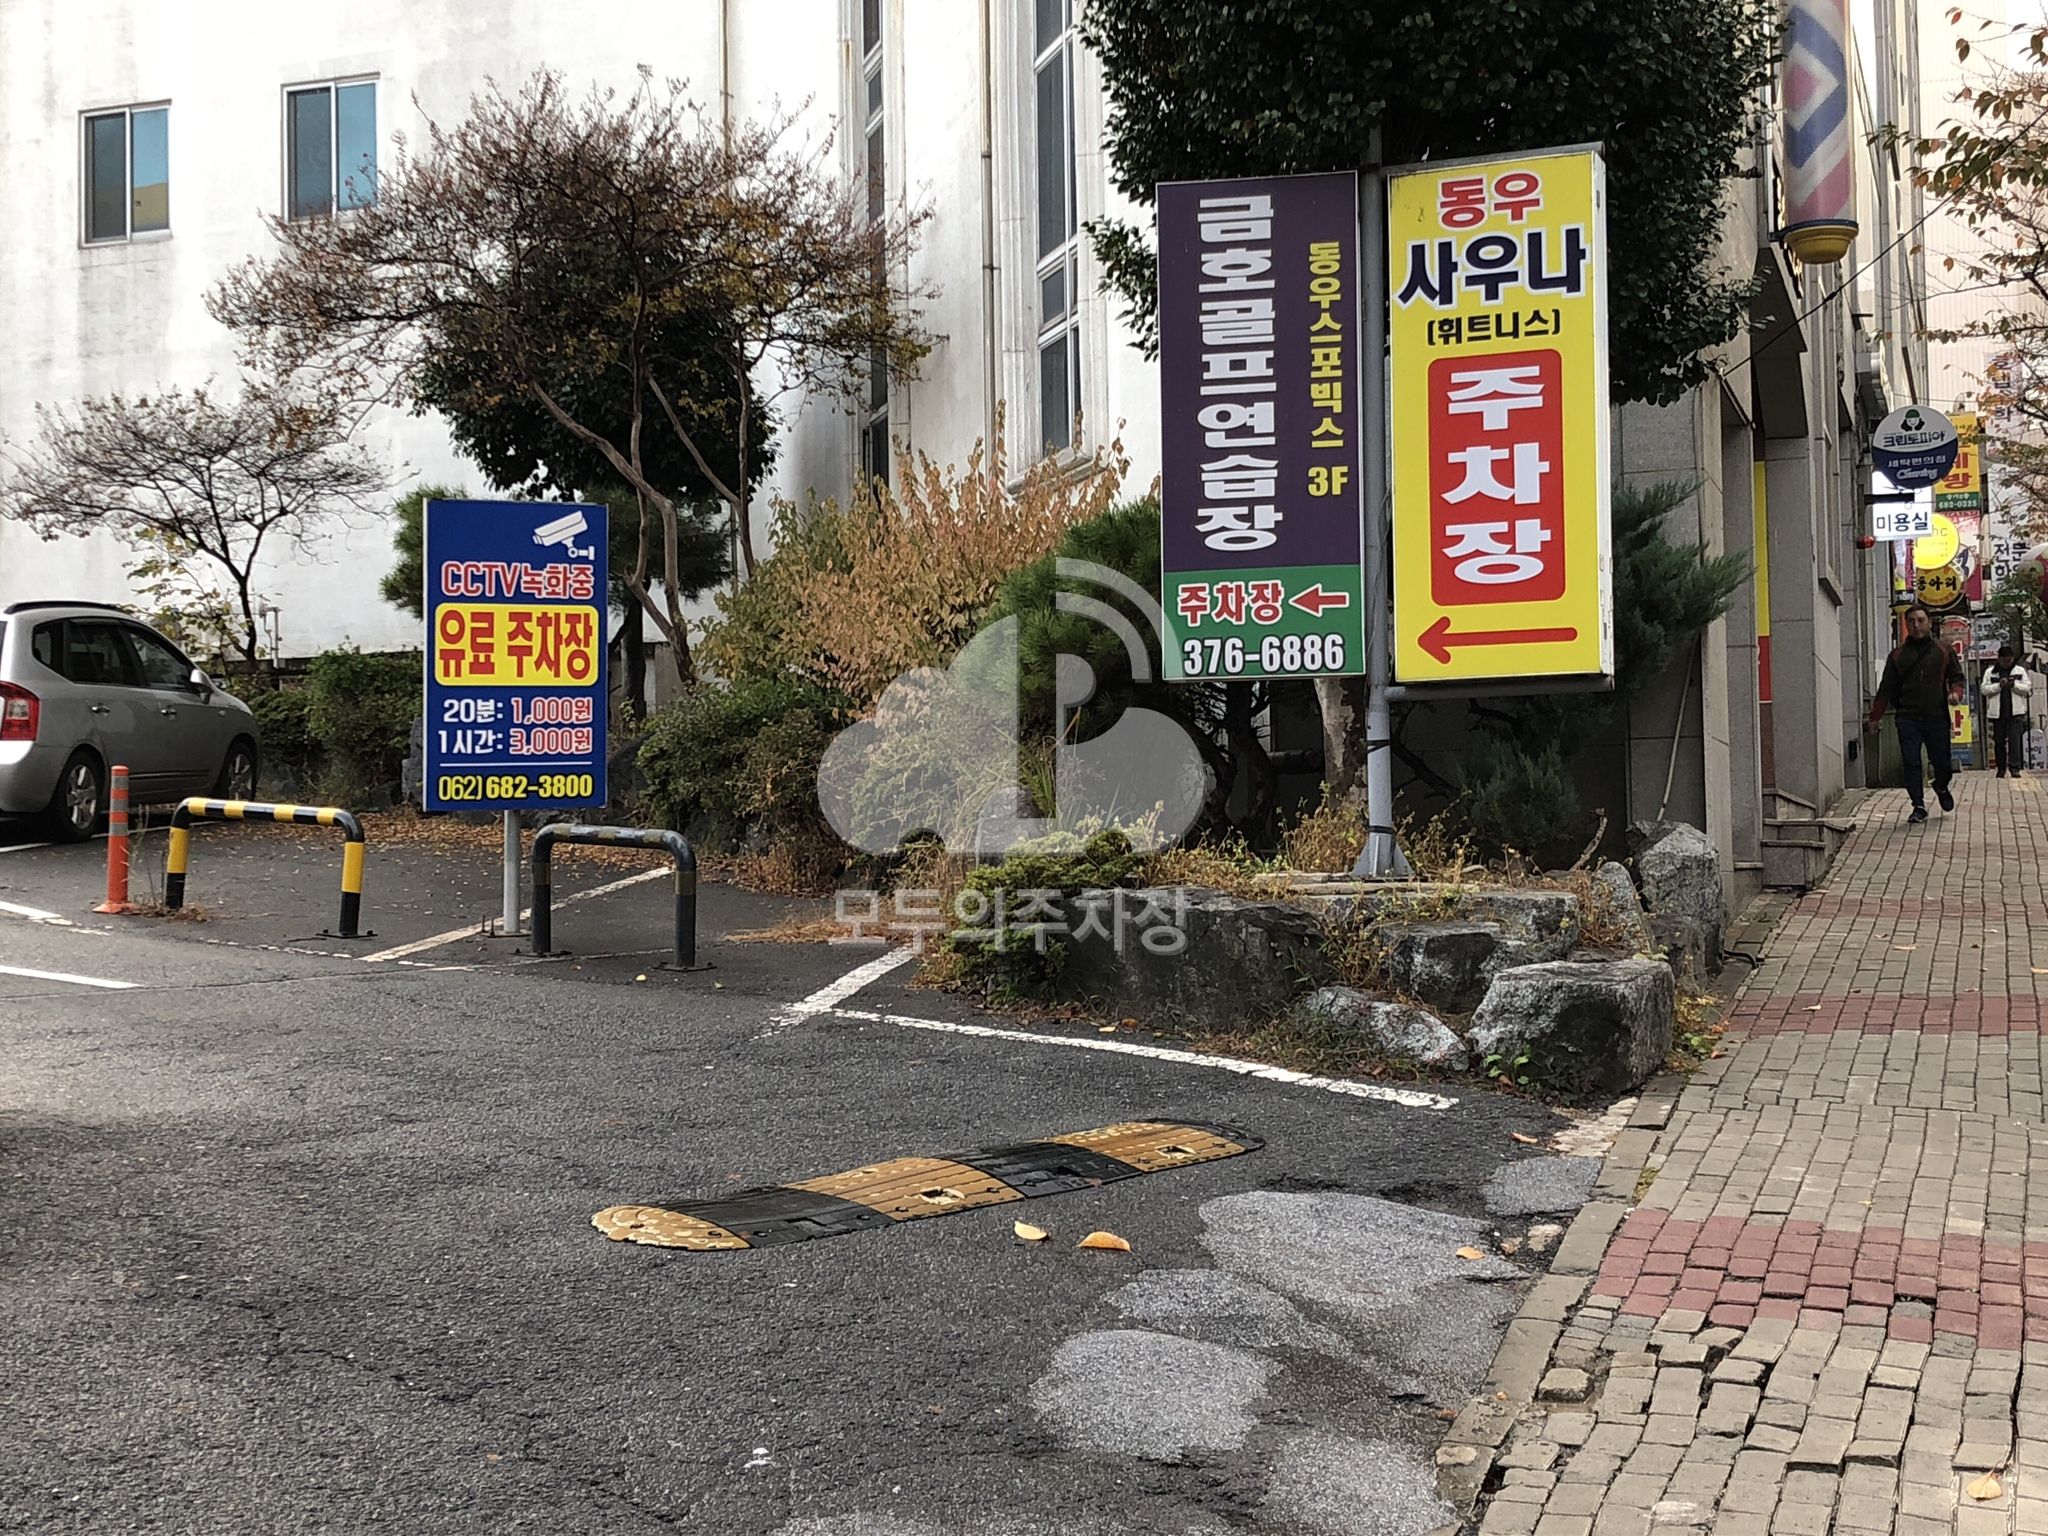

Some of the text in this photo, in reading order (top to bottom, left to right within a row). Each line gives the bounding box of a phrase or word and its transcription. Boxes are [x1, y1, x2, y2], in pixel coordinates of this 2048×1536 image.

[1438, 171, 1542, 231] 동우
[1397, 225, 1592, 310] 사우나
[1427, 309, 1561, 347] (휘트니스)
[1195, 193, 1283, 552] 금호골프연습장
[1307, 241, 1348, 498] 동우스포빅스 3F
[1883, 431, 1945, 448] 크린토피아
[1441, 365, 1552, 585] 주차장
[1876, 511, 1929, 533] 미용실
[441, 561, 595, 600] CCTV녹화중
[1177, 579, 1284, 627] 주차장
[440, 609, 593, 680] 유료 주차장
[1183, 634, 1346, 676] 376-6886
[443, 697, 593, 724] 20분: 1,000원
[509, 728, 593, 755] 3,000원
